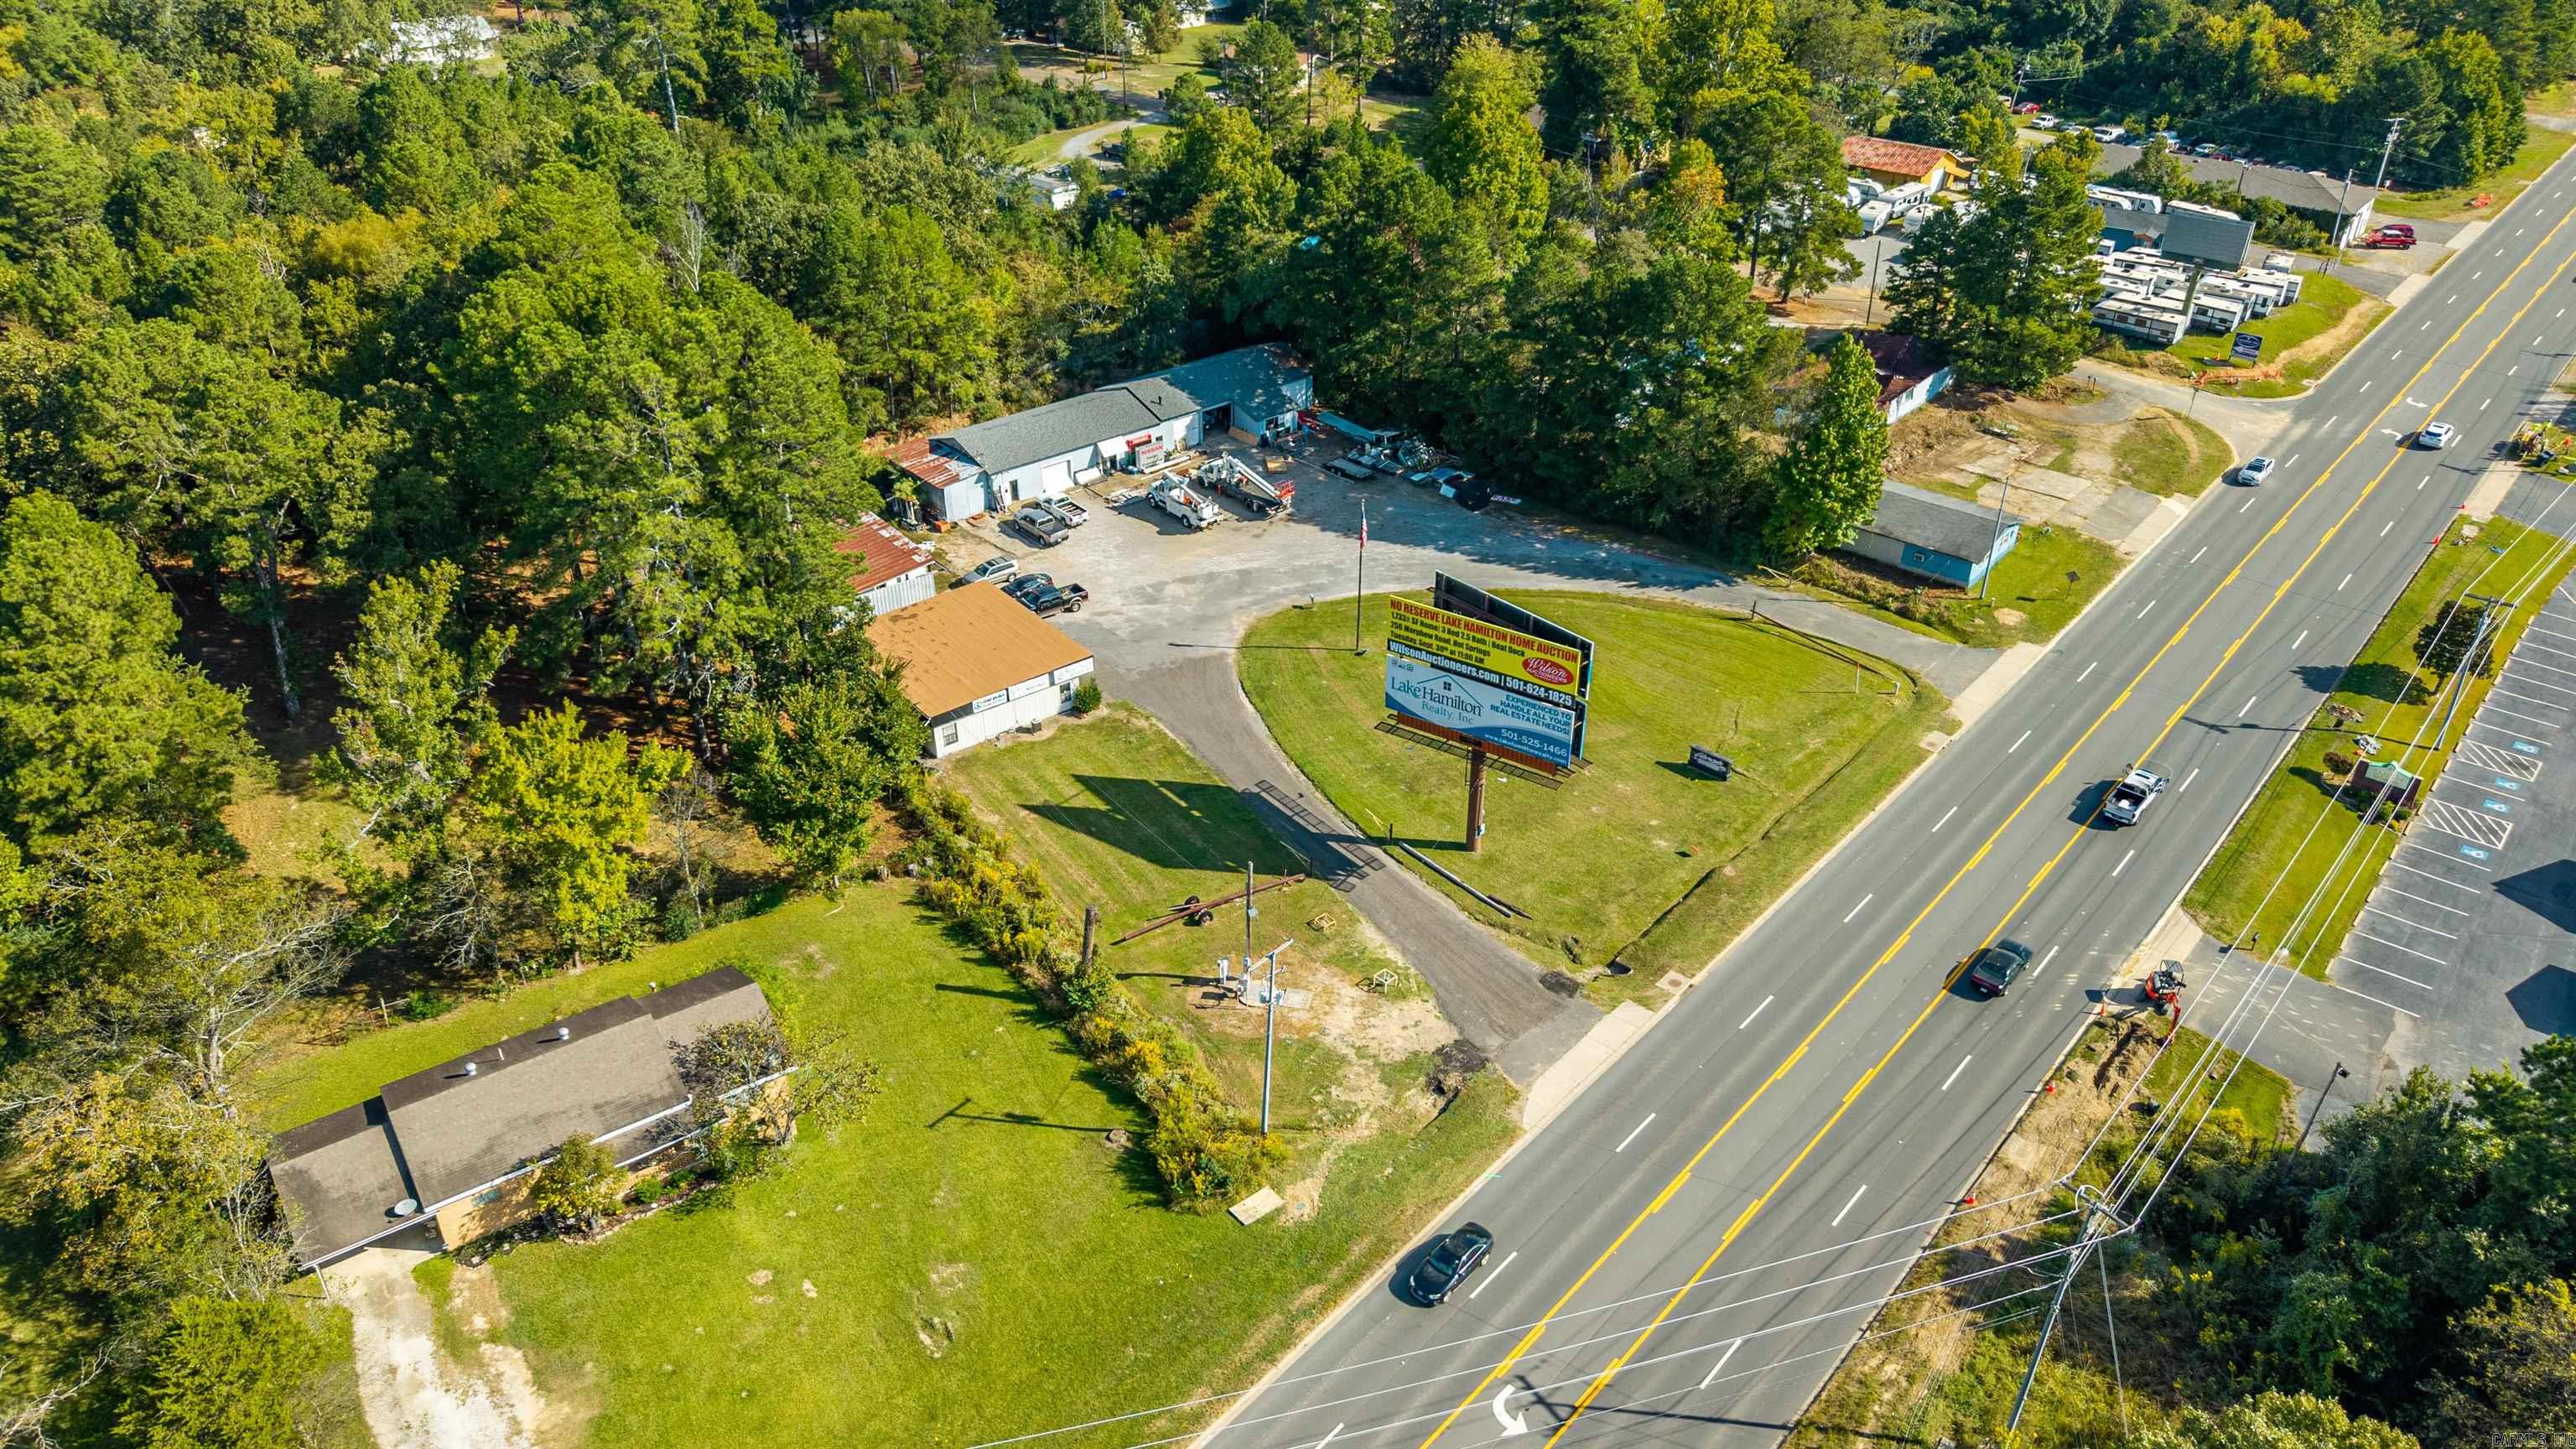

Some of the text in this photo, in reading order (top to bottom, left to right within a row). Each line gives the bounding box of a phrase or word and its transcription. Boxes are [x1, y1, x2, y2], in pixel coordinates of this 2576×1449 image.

[1390, 599, 1578, 663] NO RESERVE LAKE HAMILTON HOME AUCTION
[1452, 640, 1464, 649] Hot
[1465, 643, 1491, 657] Springs
[1472, 635, 1488, 646] Bath
[1492, 641, 1507, 651] Boat
[1509, 646, 1525, 657] Dock
[1389, 640, 1499, 683] WilsonAuctioneers.com
[1506, 677, 1572, 706] 501-624-1825
[1474, 656, 1485, 665] AM
[1528, 657, 1568, 678] Wilson
[1526, 667, 1568, 684] AUCTIONEERS
[1390, 676, 1482, 717] Lake Hamilton
[1506, 693, 1571, 720] EXPERIENCED TO
[1490, 704, 1570, 735] REAL ESTATE NEEDS!
[1500, 699, 1571, 727] HANDLE ALL YOUR
[1501, 728, 1568, 757] 501-525-1466
